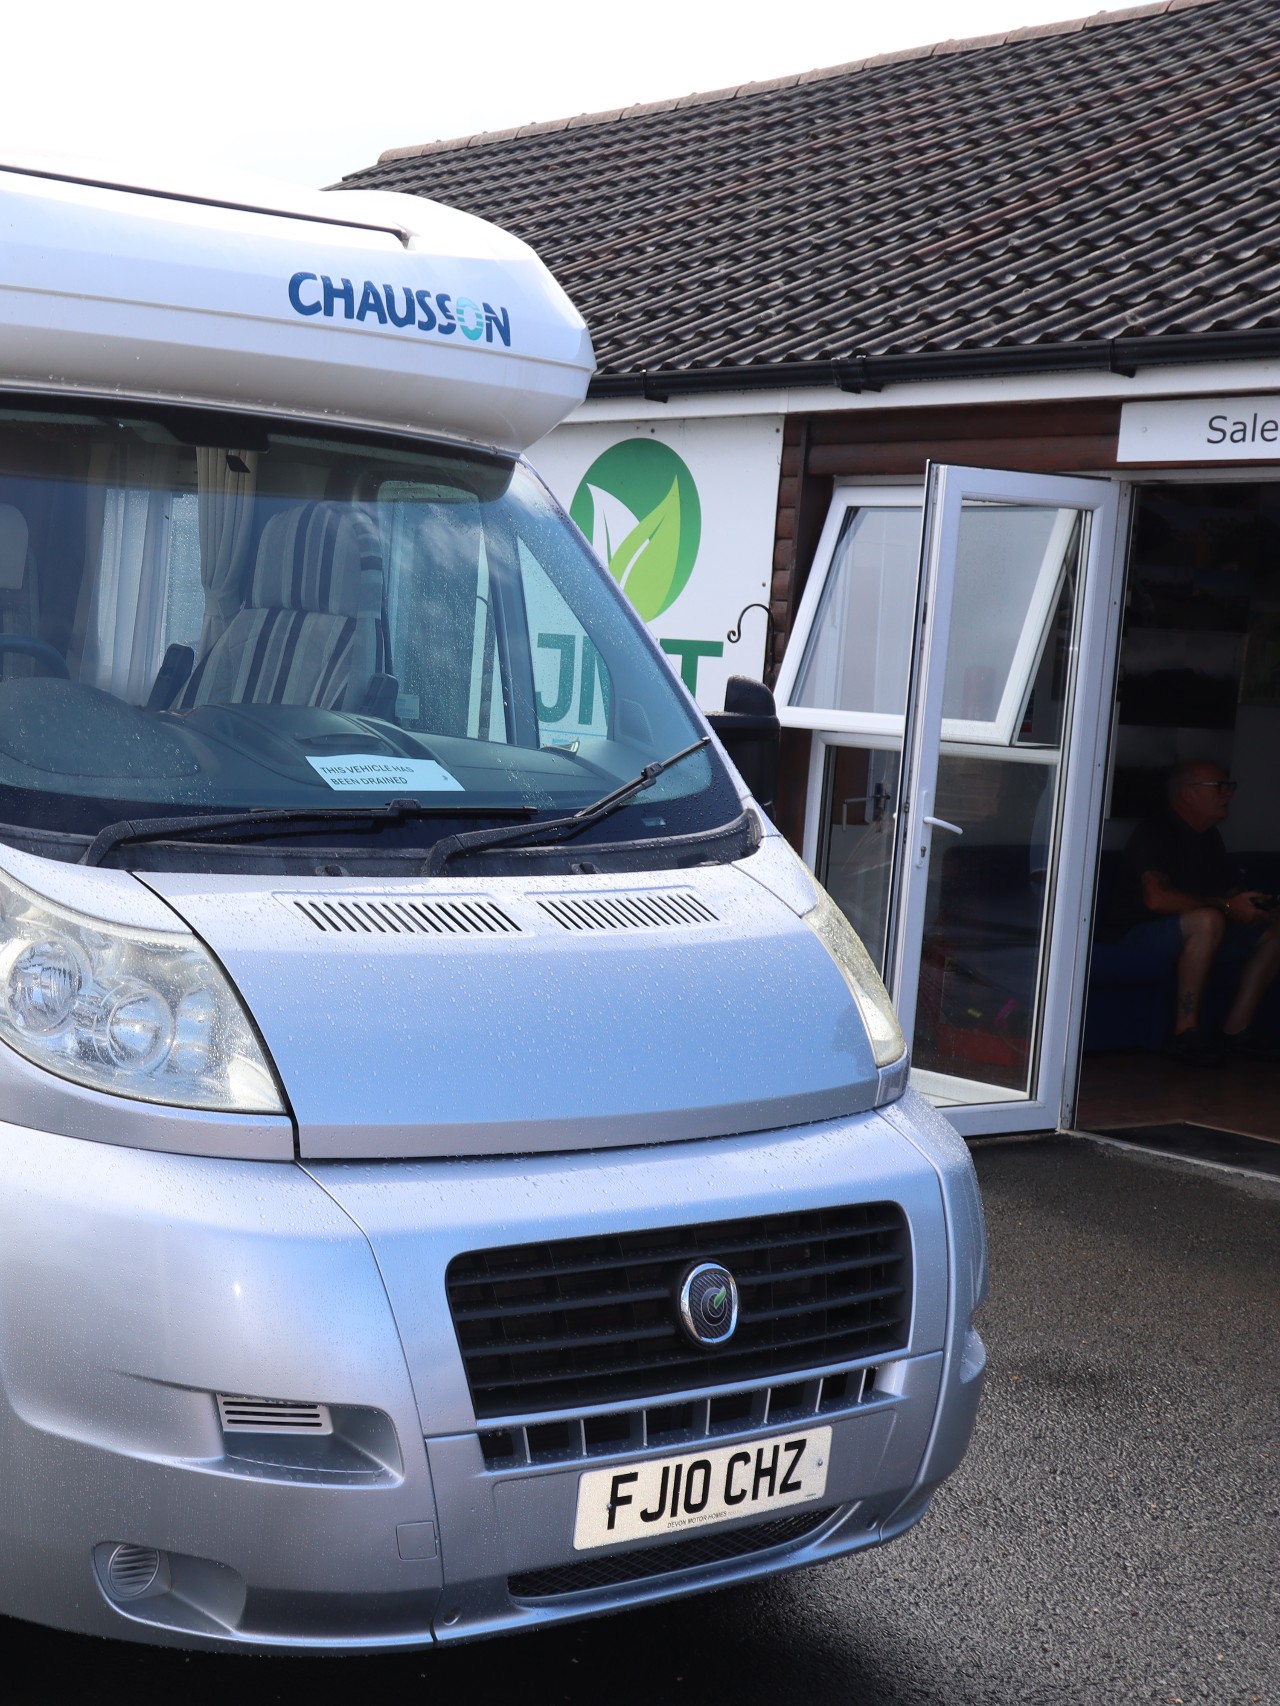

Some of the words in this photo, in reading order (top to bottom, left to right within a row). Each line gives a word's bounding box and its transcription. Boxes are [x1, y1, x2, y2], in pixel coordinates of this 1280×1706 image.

[288, 271, 511, 347] CHAUSSON
[1206, 412, 1279, 444] Sale
[320, 766, 347, 774] THIS
[346, 764, 390, 774] VEHICLE
[391, 765, 415, 774] HAS
[330, 777, 361, 786] BEEN
[361, 776, 408, 786] DRAINED
[606, 1458, 713, 1531] FJ10
[723, 1438, 808, 1506] CHZ
[667, 1519, 687, 1529] DEVON
[687, 1514, 708, 1526] MOTOR
[707, 1510, 728, 1521] HOMES
